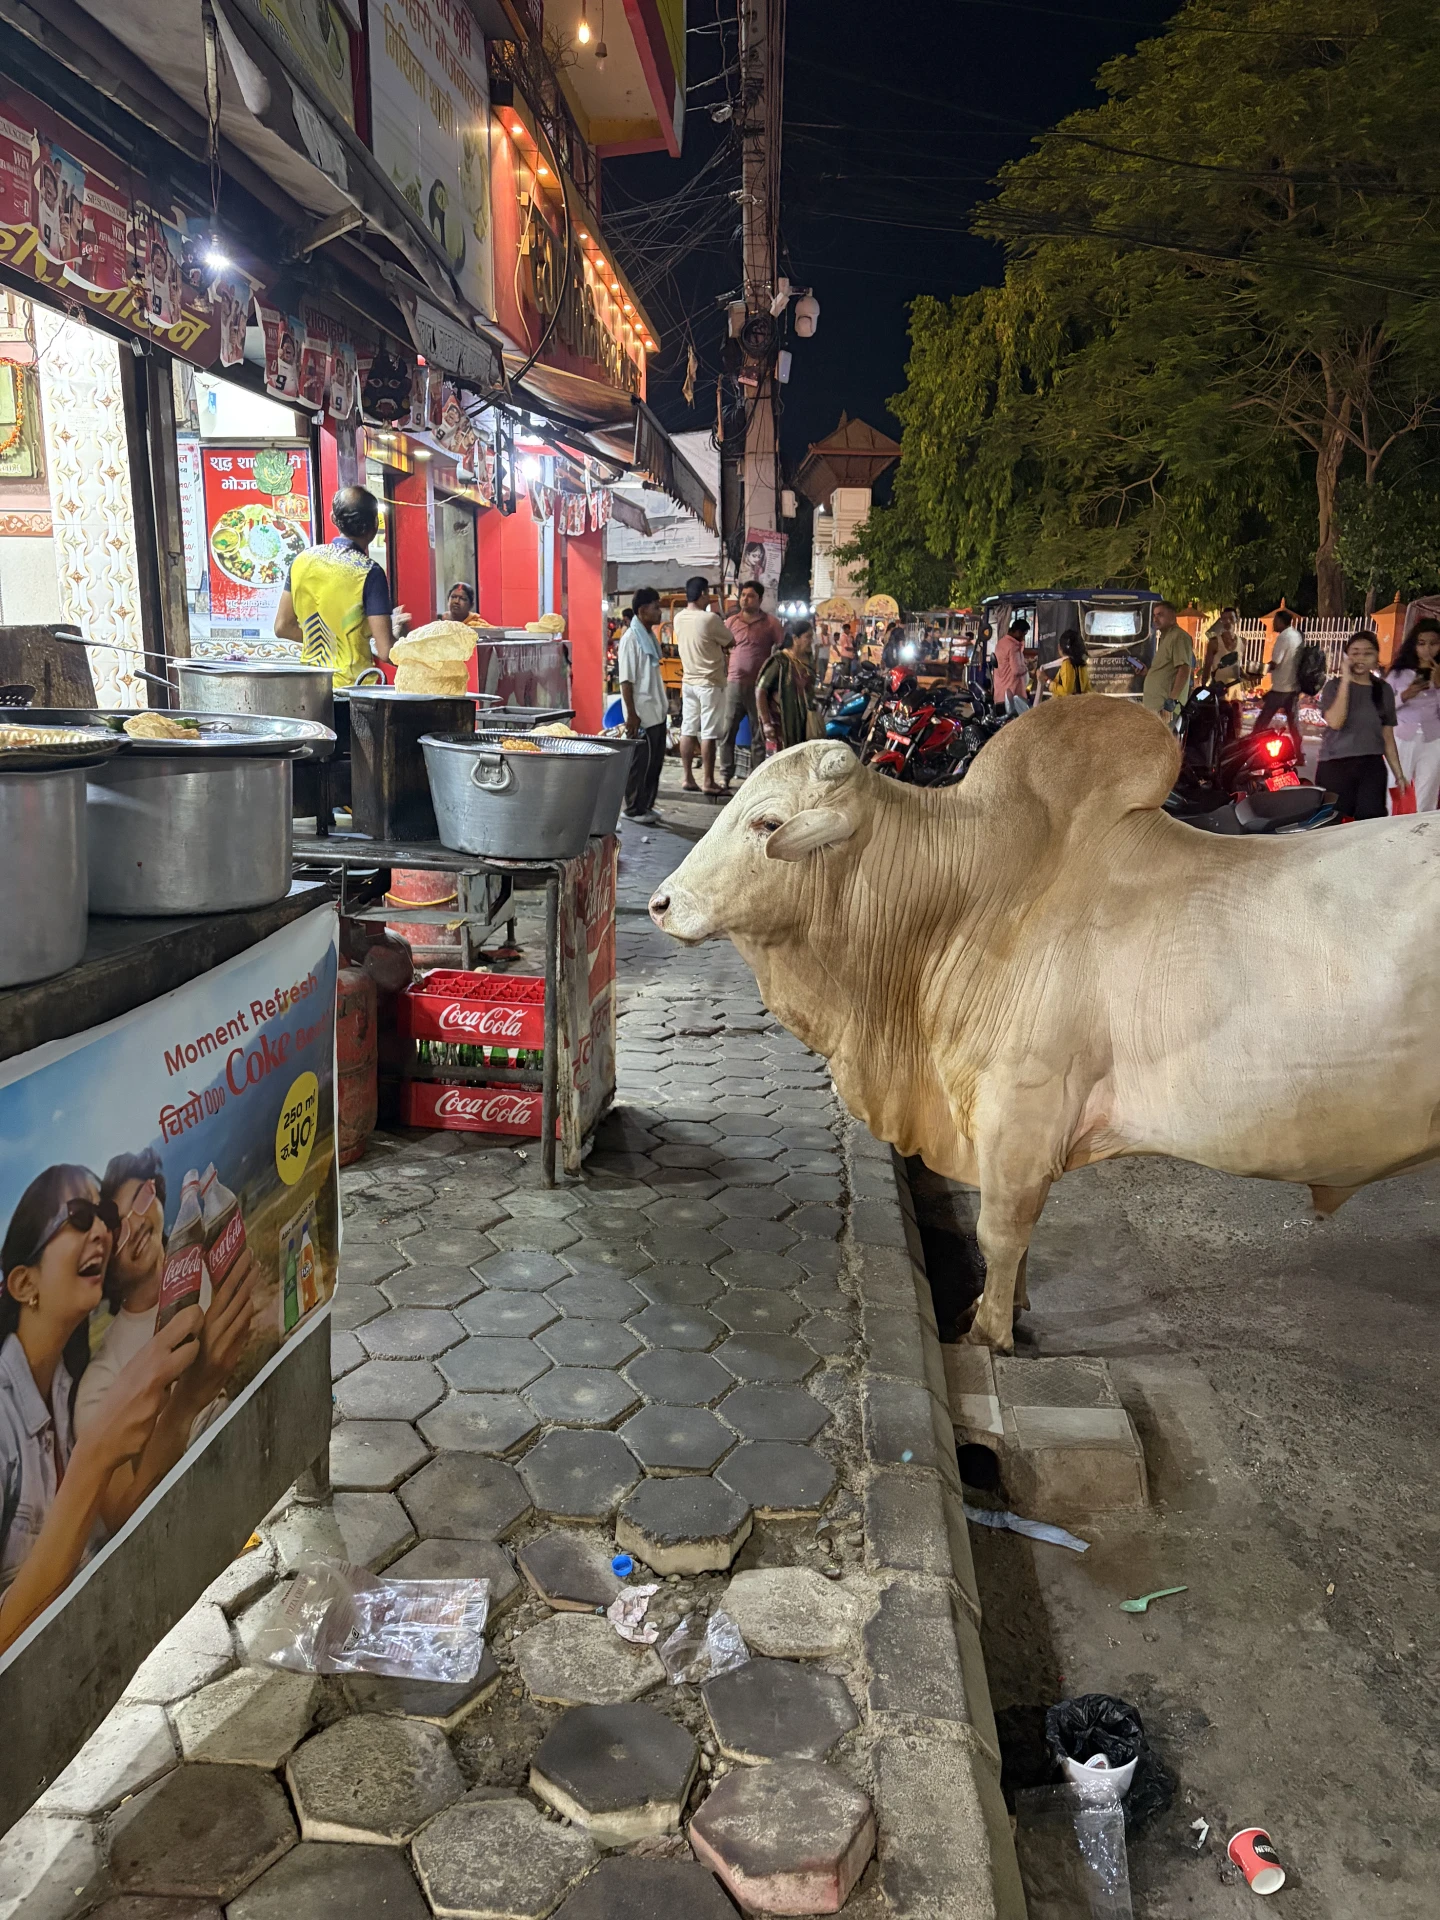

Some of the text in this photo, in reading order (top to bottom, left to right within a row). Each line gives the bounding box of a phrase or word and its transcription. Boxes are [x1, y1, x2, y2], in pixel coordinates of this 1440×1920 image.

[384, 3, 425, 103] मिथिला
[13, 149, 30, 171] WIN
[112, 223, 125, 242] WIN
[210, 456, 233, 472] शुद्ध
[164, 1010, 249, 1076] Moment
[249, 972, 318, 1026] Refresh
[438, 1003, 529, 1037] Coca-Cola
[159, 1090, 204, 1144] चिसो
[226, 1033, 291, 1096] Coke
[283, 1101, 303, 1130] 250
[434, 1089, 538, 1125] Coca-Cola
[210, 1213, 242, 1274] Coca-Cola
[163, 1246, 200, 1291] Coca-Cola
